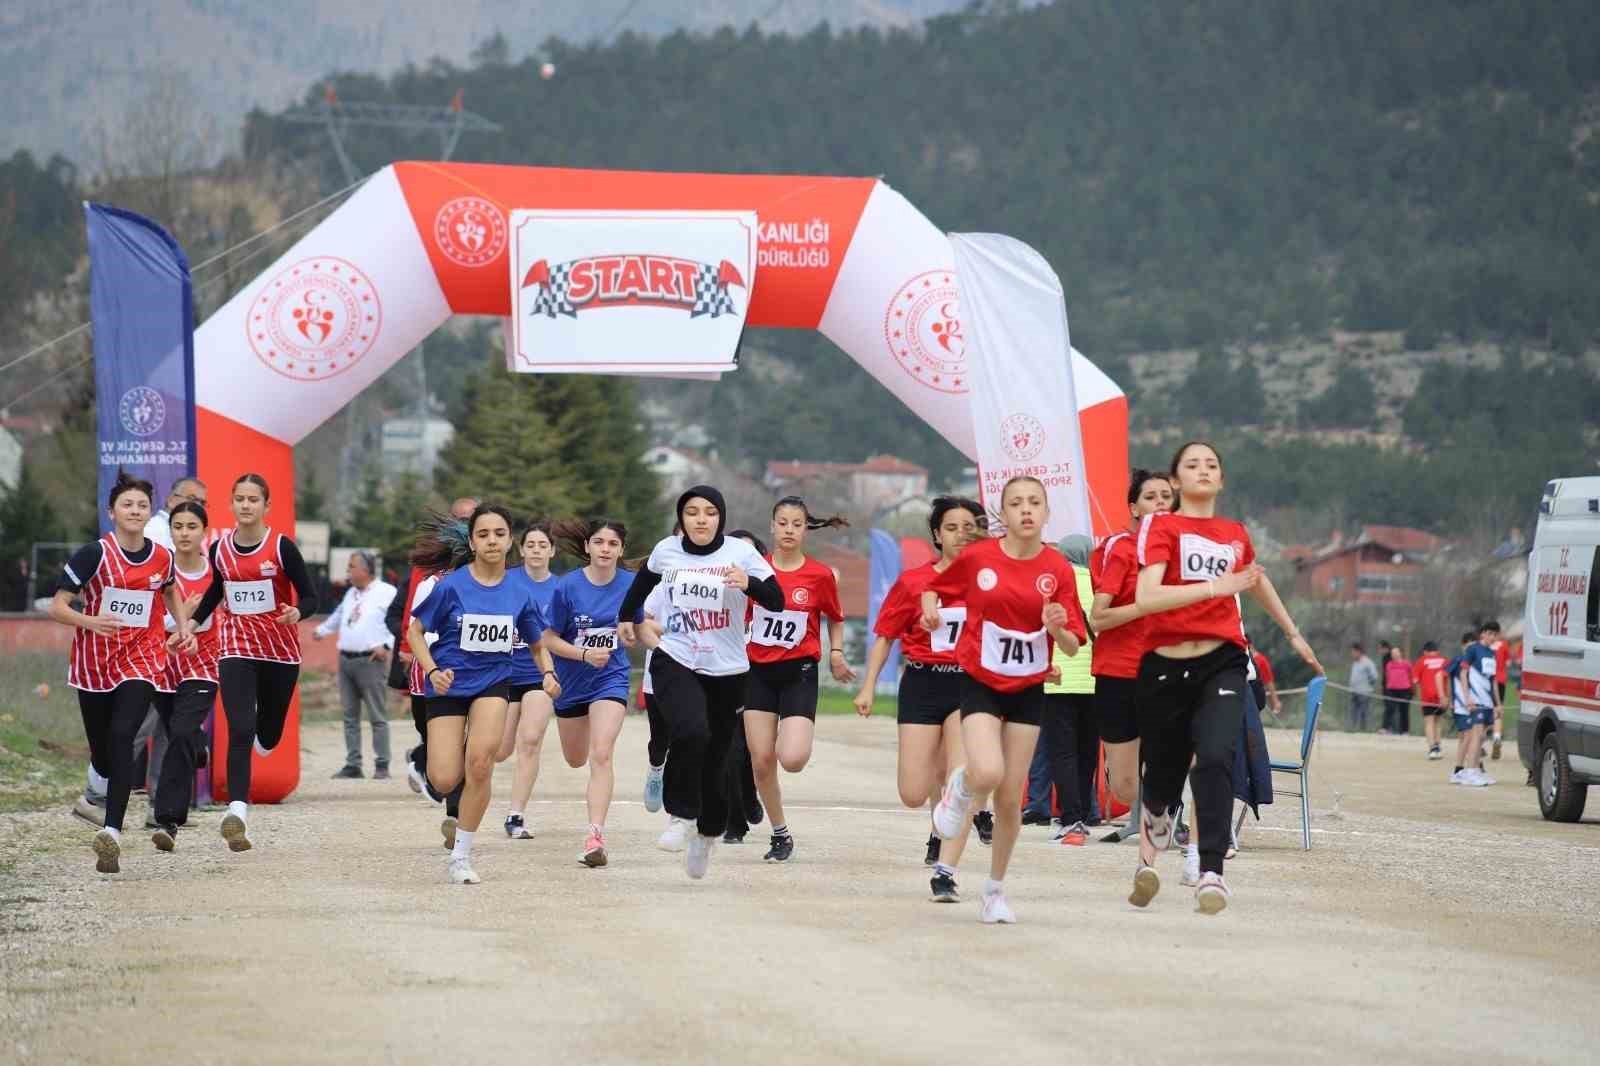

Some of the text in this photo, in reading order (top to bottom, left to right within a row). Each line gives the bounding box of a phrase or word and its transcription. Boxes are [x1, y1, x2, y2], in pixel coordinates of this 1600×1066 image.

[567, 256, 698, 302] START
[1187, 552, 1228, 577] 048
[234, 591, 265, 602] 6712
[680, 583, 719, 600] 1404
[110, 600, 143, 616] 6709
[1548, 601, 1569, 636] 112
[468, 623, 508, 642] 7804
[763, 616, 797, 642] 742
[1000, 637, 1034, 665] 741
